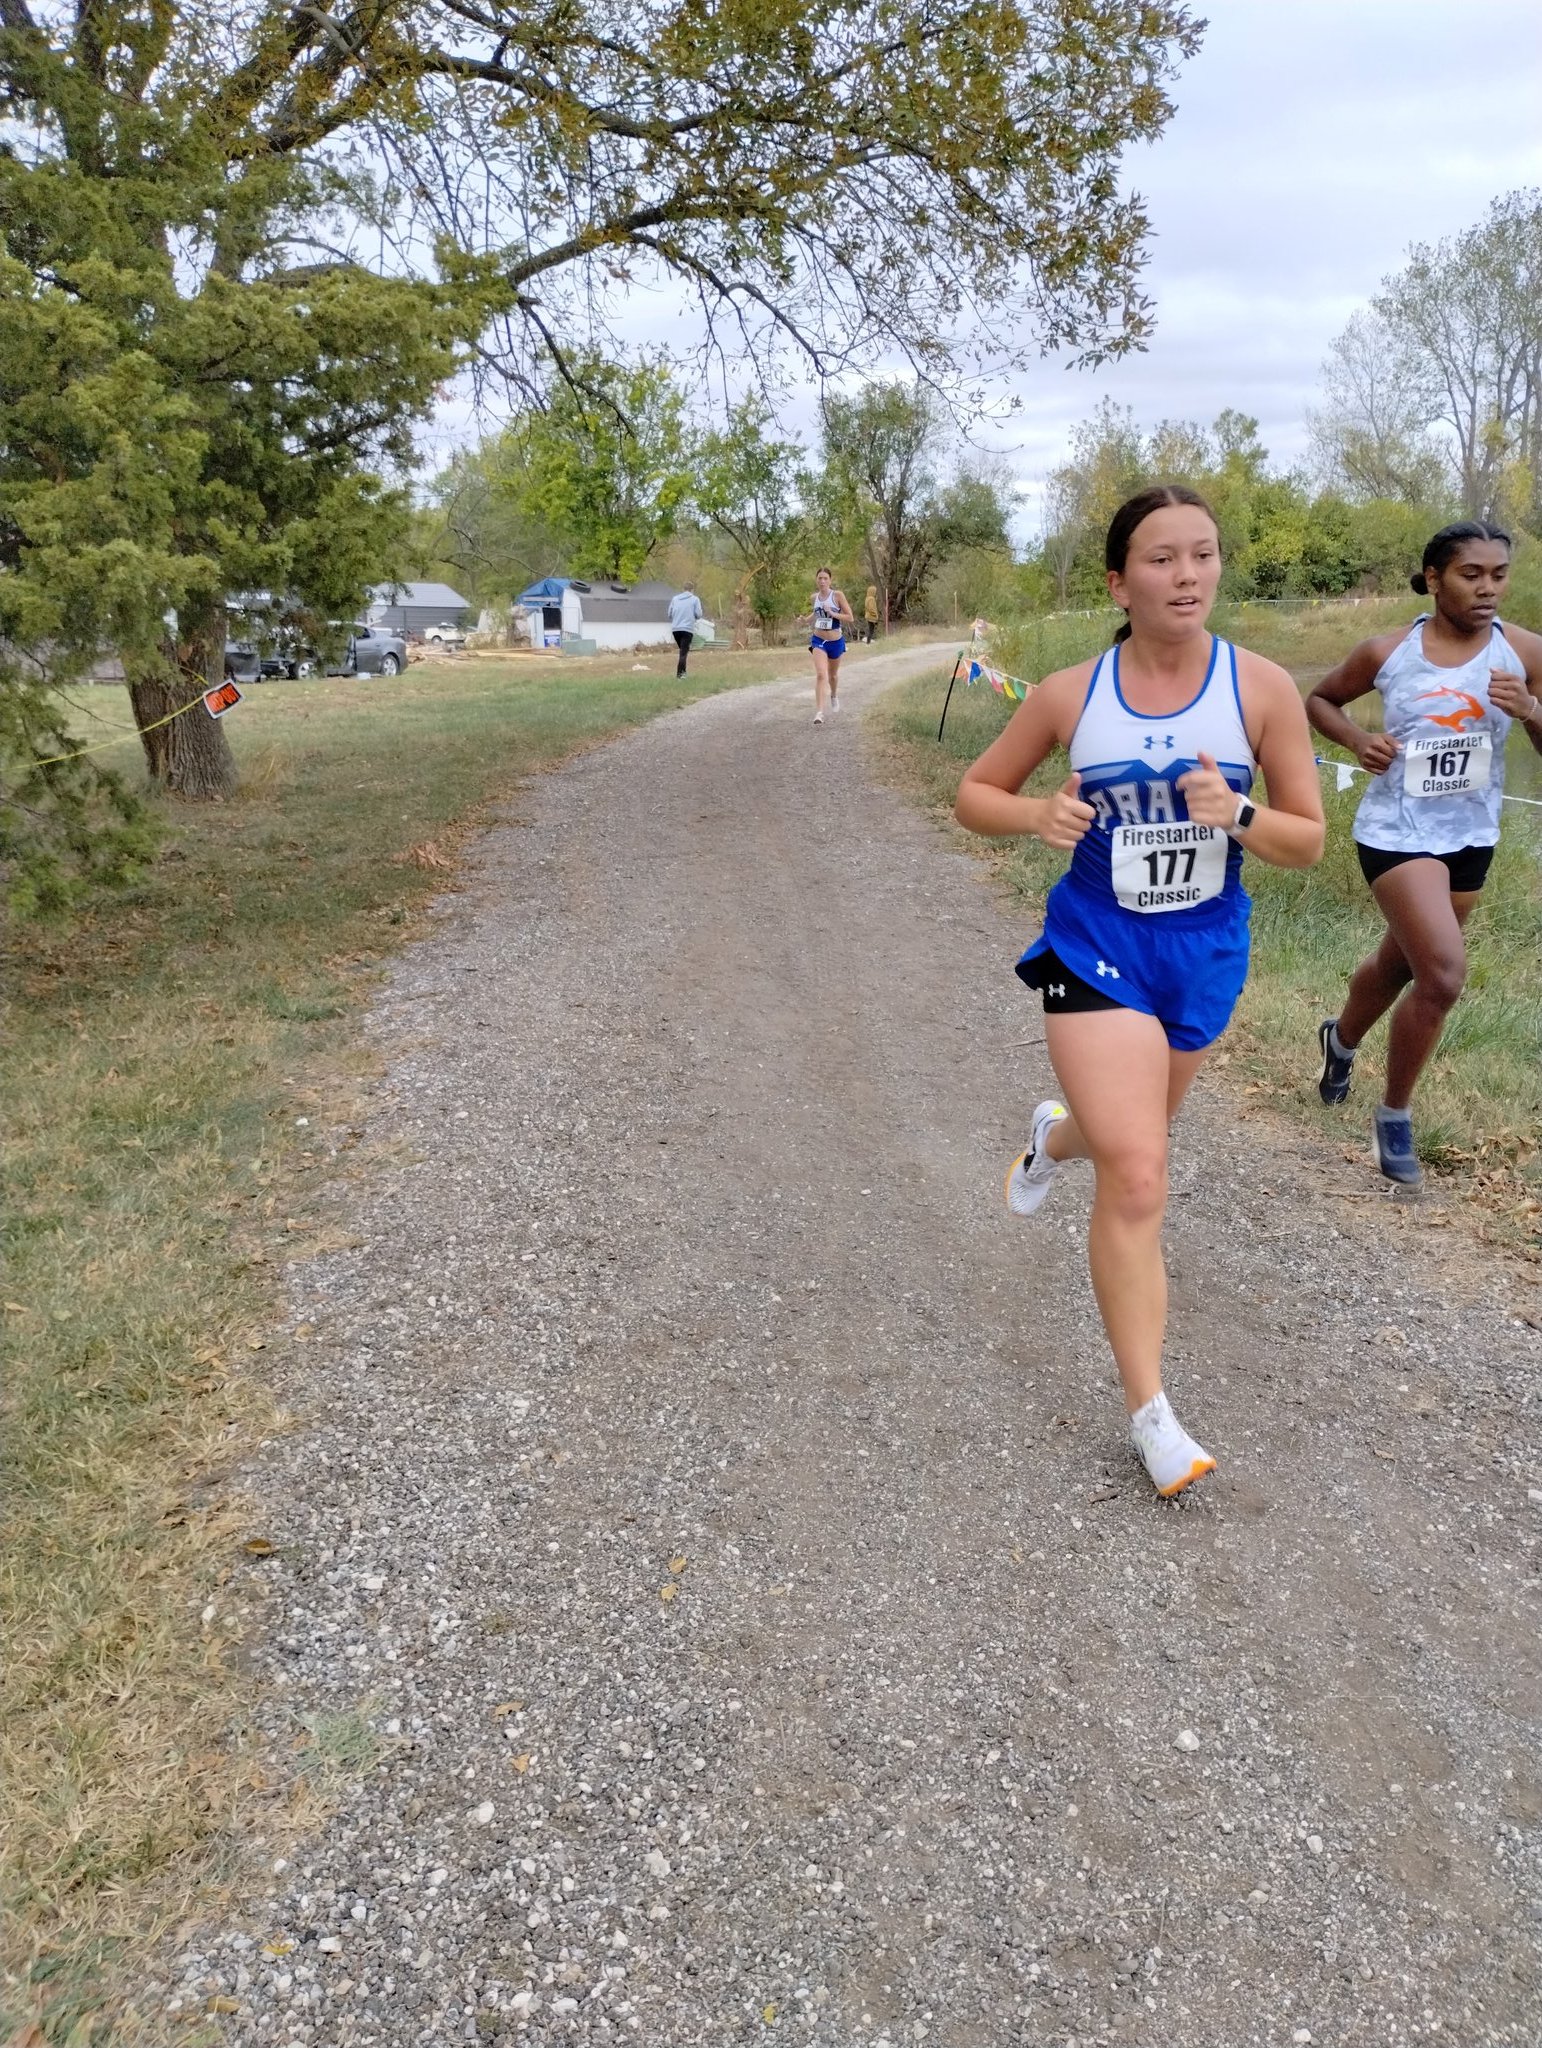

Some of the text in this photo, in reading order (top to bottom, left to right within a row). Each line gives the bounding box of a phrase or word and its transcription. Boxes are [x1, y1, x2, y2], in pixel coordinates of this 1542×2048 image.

[1415, 735, 1483, 751] Firestarter
[1426, 750, 1471, 777] 167
[1422, 778, 1470, 792] Classic
[1088, 780, 1176, 834] PRA
[1122, 825, 1215, 846] Firestarter
[1142, 848, 1197, 886] 177
[1138, 886, 1200, 907] Classic
